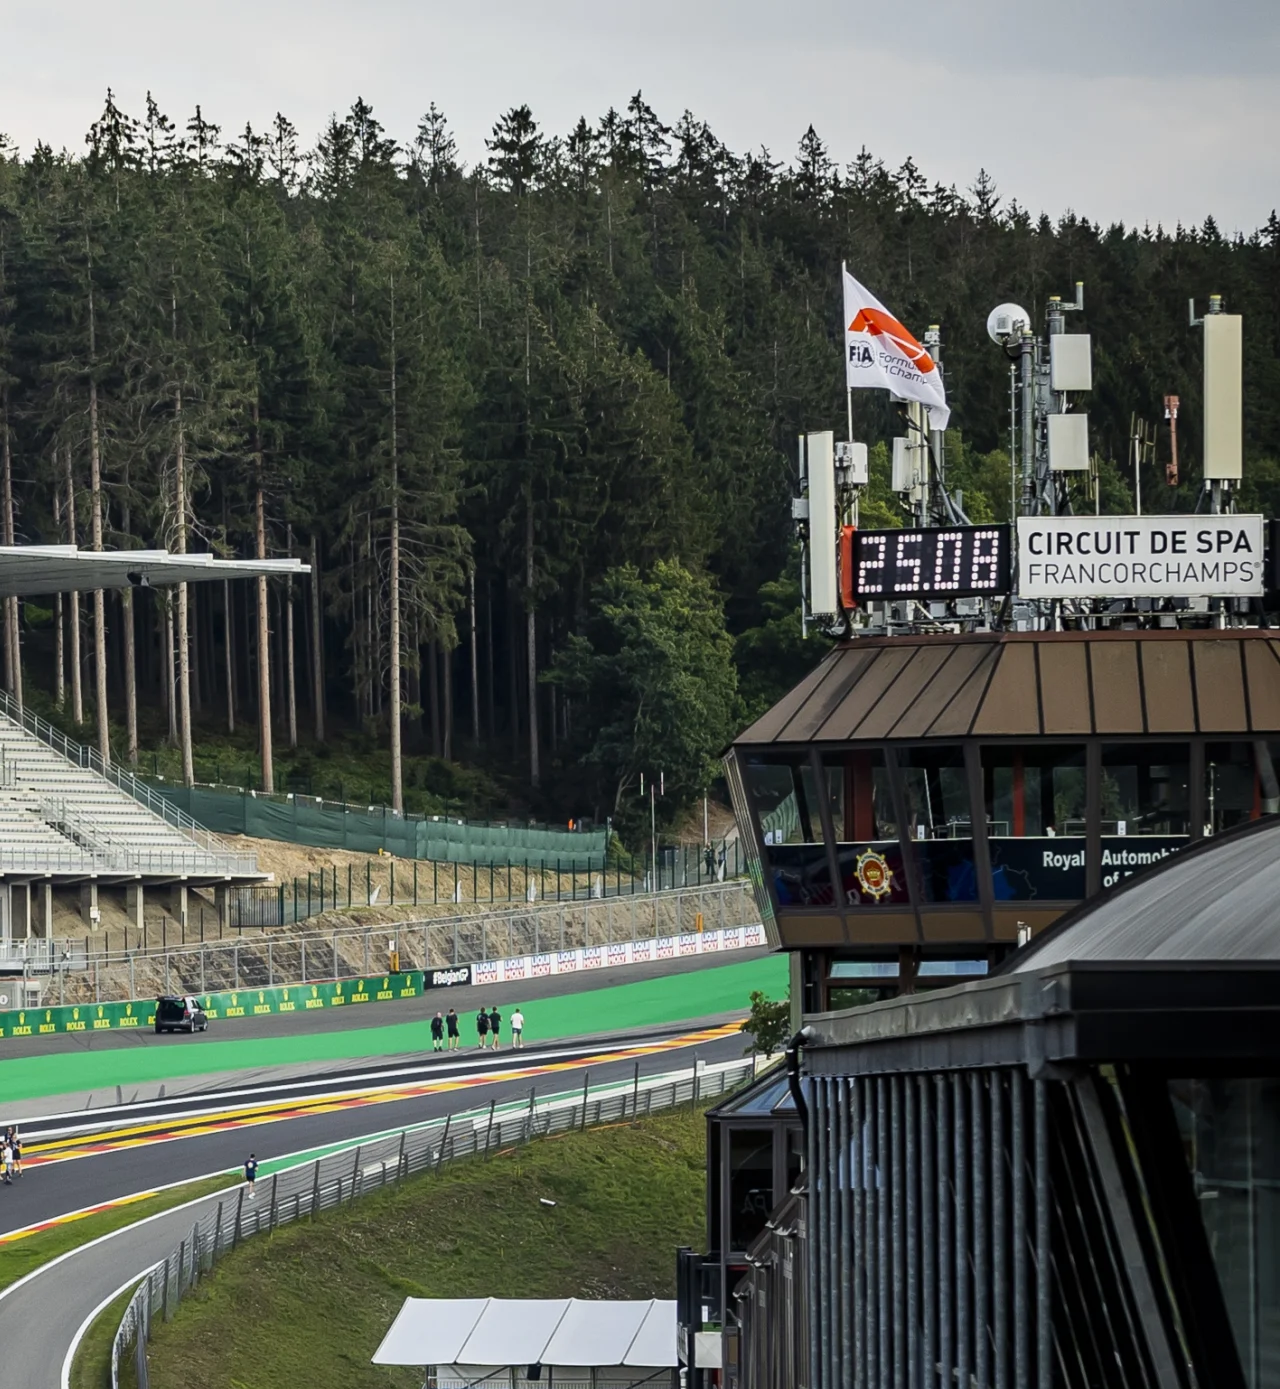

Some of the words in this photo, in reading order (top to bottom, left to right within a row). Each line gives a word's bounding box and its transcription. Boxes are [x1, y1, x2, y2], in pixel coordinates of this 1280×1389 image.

[1028, 531, 1140, 556] CIRCUIT
[1150, 530, 1188, 554] DE
[1196, 529, 1253, 554] SPA
[858, 531, 1000, 593] 25.08
[1042, 850, 1085, 871] Royal
